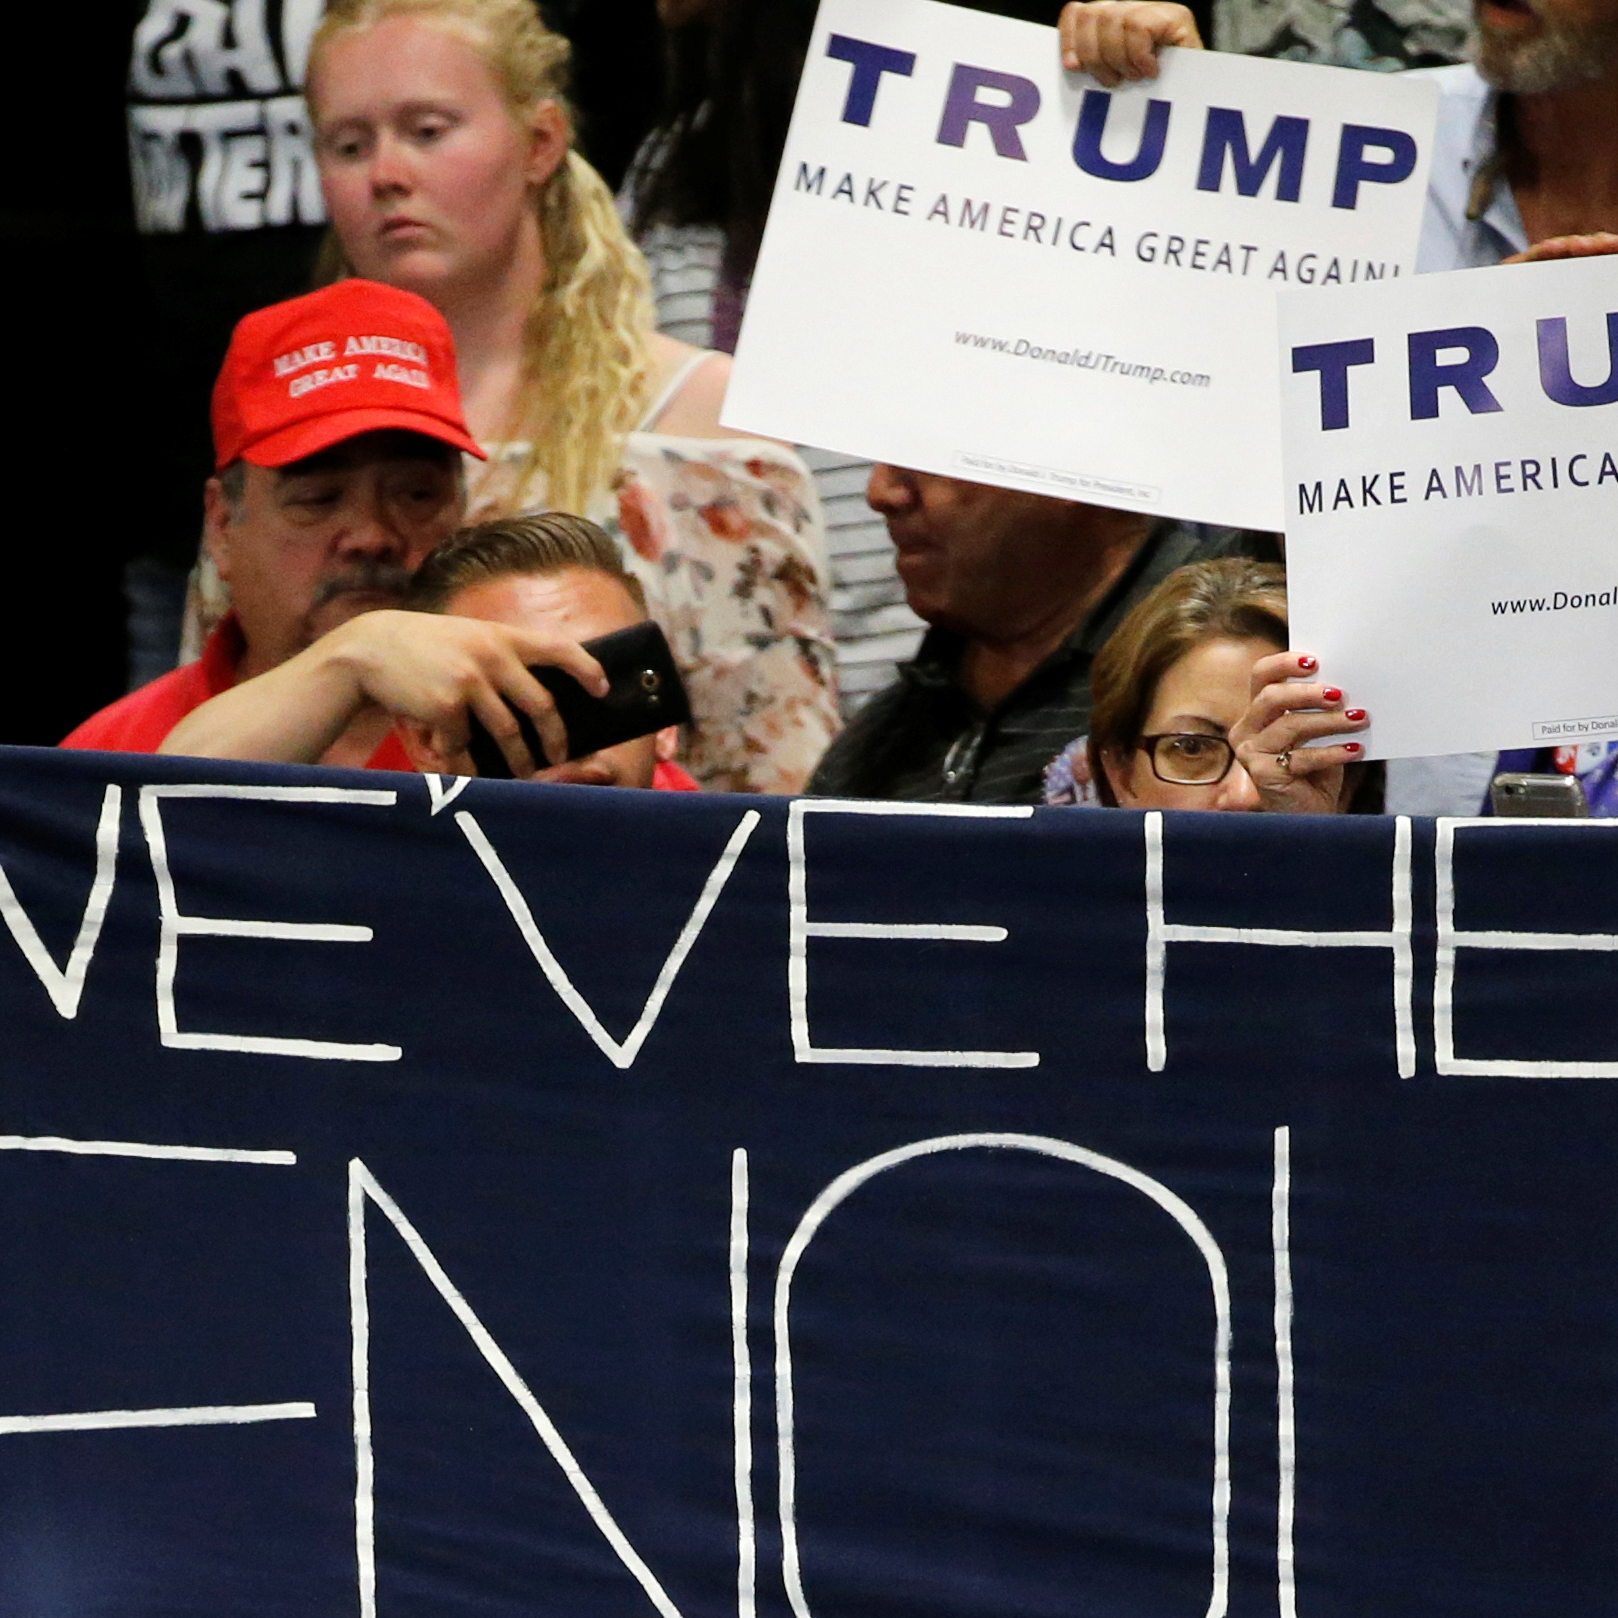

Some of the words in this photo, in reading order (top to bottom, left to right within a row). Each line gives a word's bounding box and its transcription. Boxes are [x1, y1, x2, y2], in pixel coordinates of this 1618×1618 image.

[826, 33, 1417, 210] TRUMP
[793, 161, 915, 216] MAKE
[927, 193, 1118, 256] AMERICA
[1136, 232, 1259, 276] GREAT
[273, 340, 337, 378] MAKE
[288, 363, 360, 399] GREAT
[954, 330, 1211, 388] www.DonaldJTrump.com
[1298, 471, 1407, 516] MAKE
[1541, 724, 1561, 735] Paid
[1562, 722, 1576, 733] for
[1577, 721, 1589, 734] by
